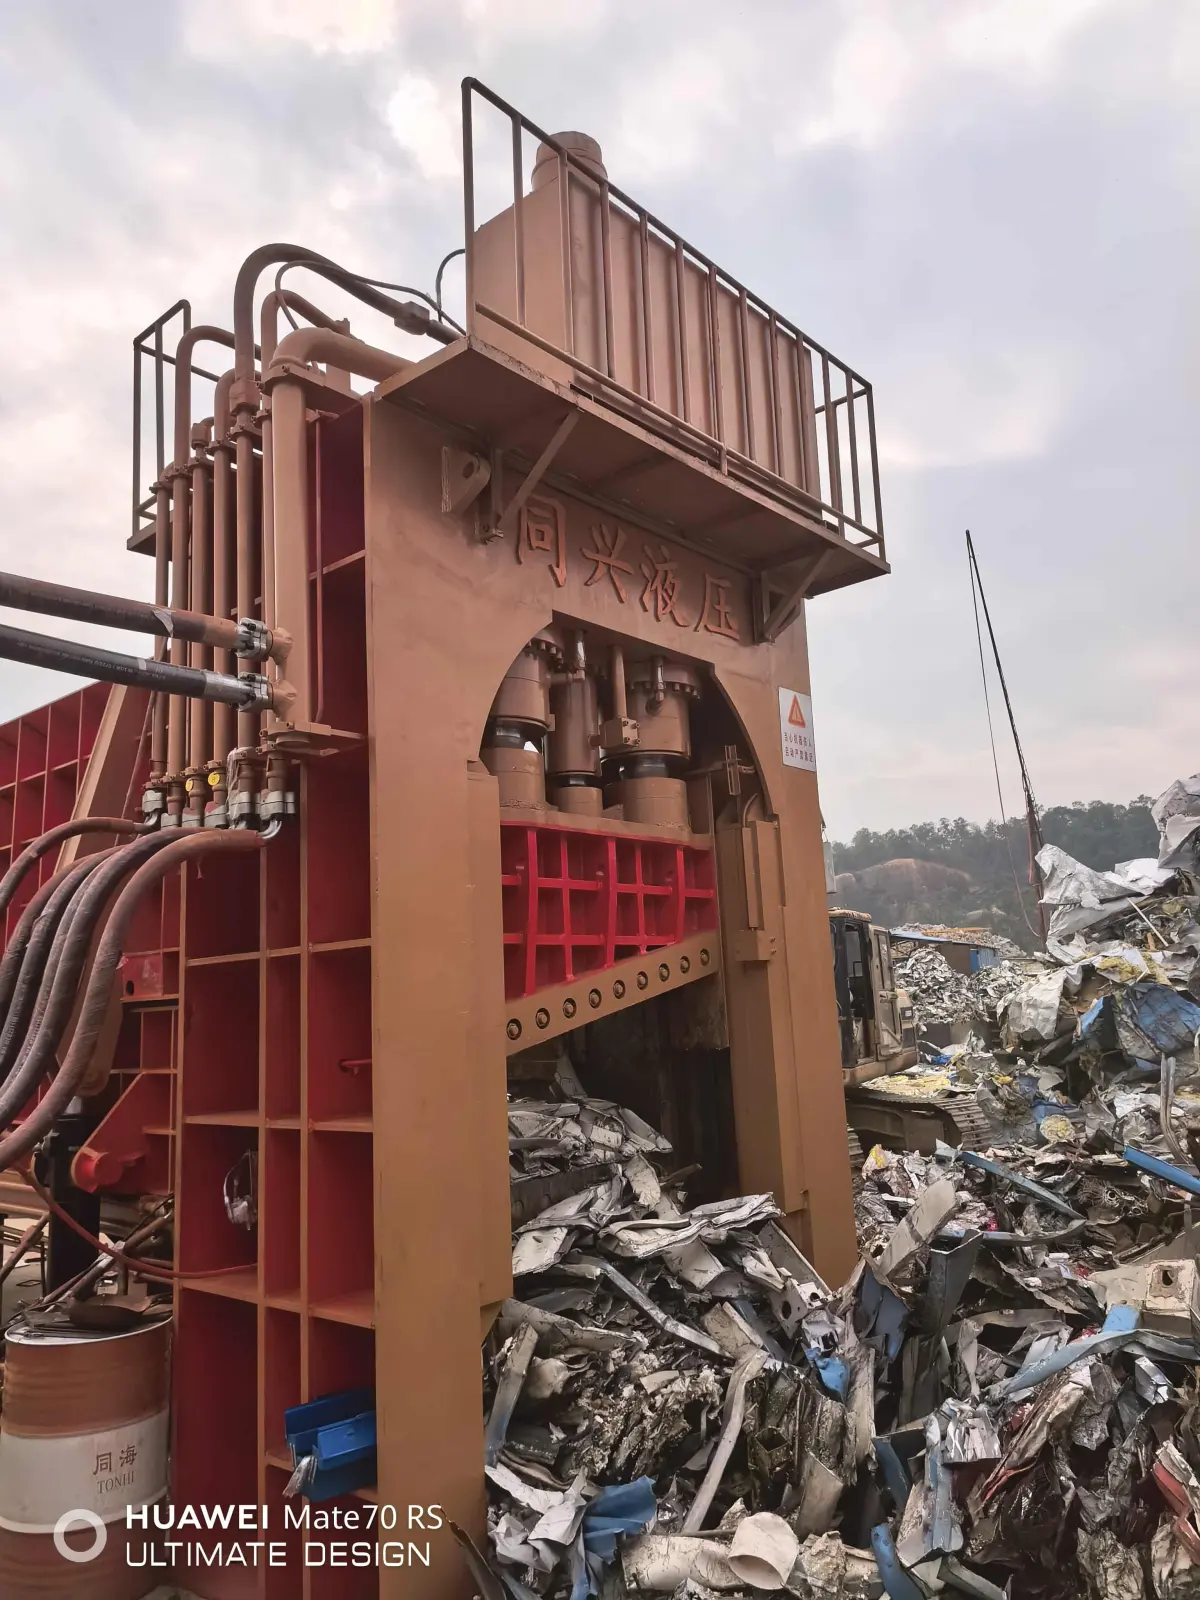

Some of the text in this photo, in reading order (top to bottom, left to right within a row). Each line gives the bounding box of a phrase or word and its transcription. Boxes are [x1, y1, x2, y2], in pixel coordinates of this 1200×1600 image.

[516, 494, 741, 641] 同兴液压
[92, 1443, 138, 1475] 同海
[97, 1471, 134, 1493] TONHI
